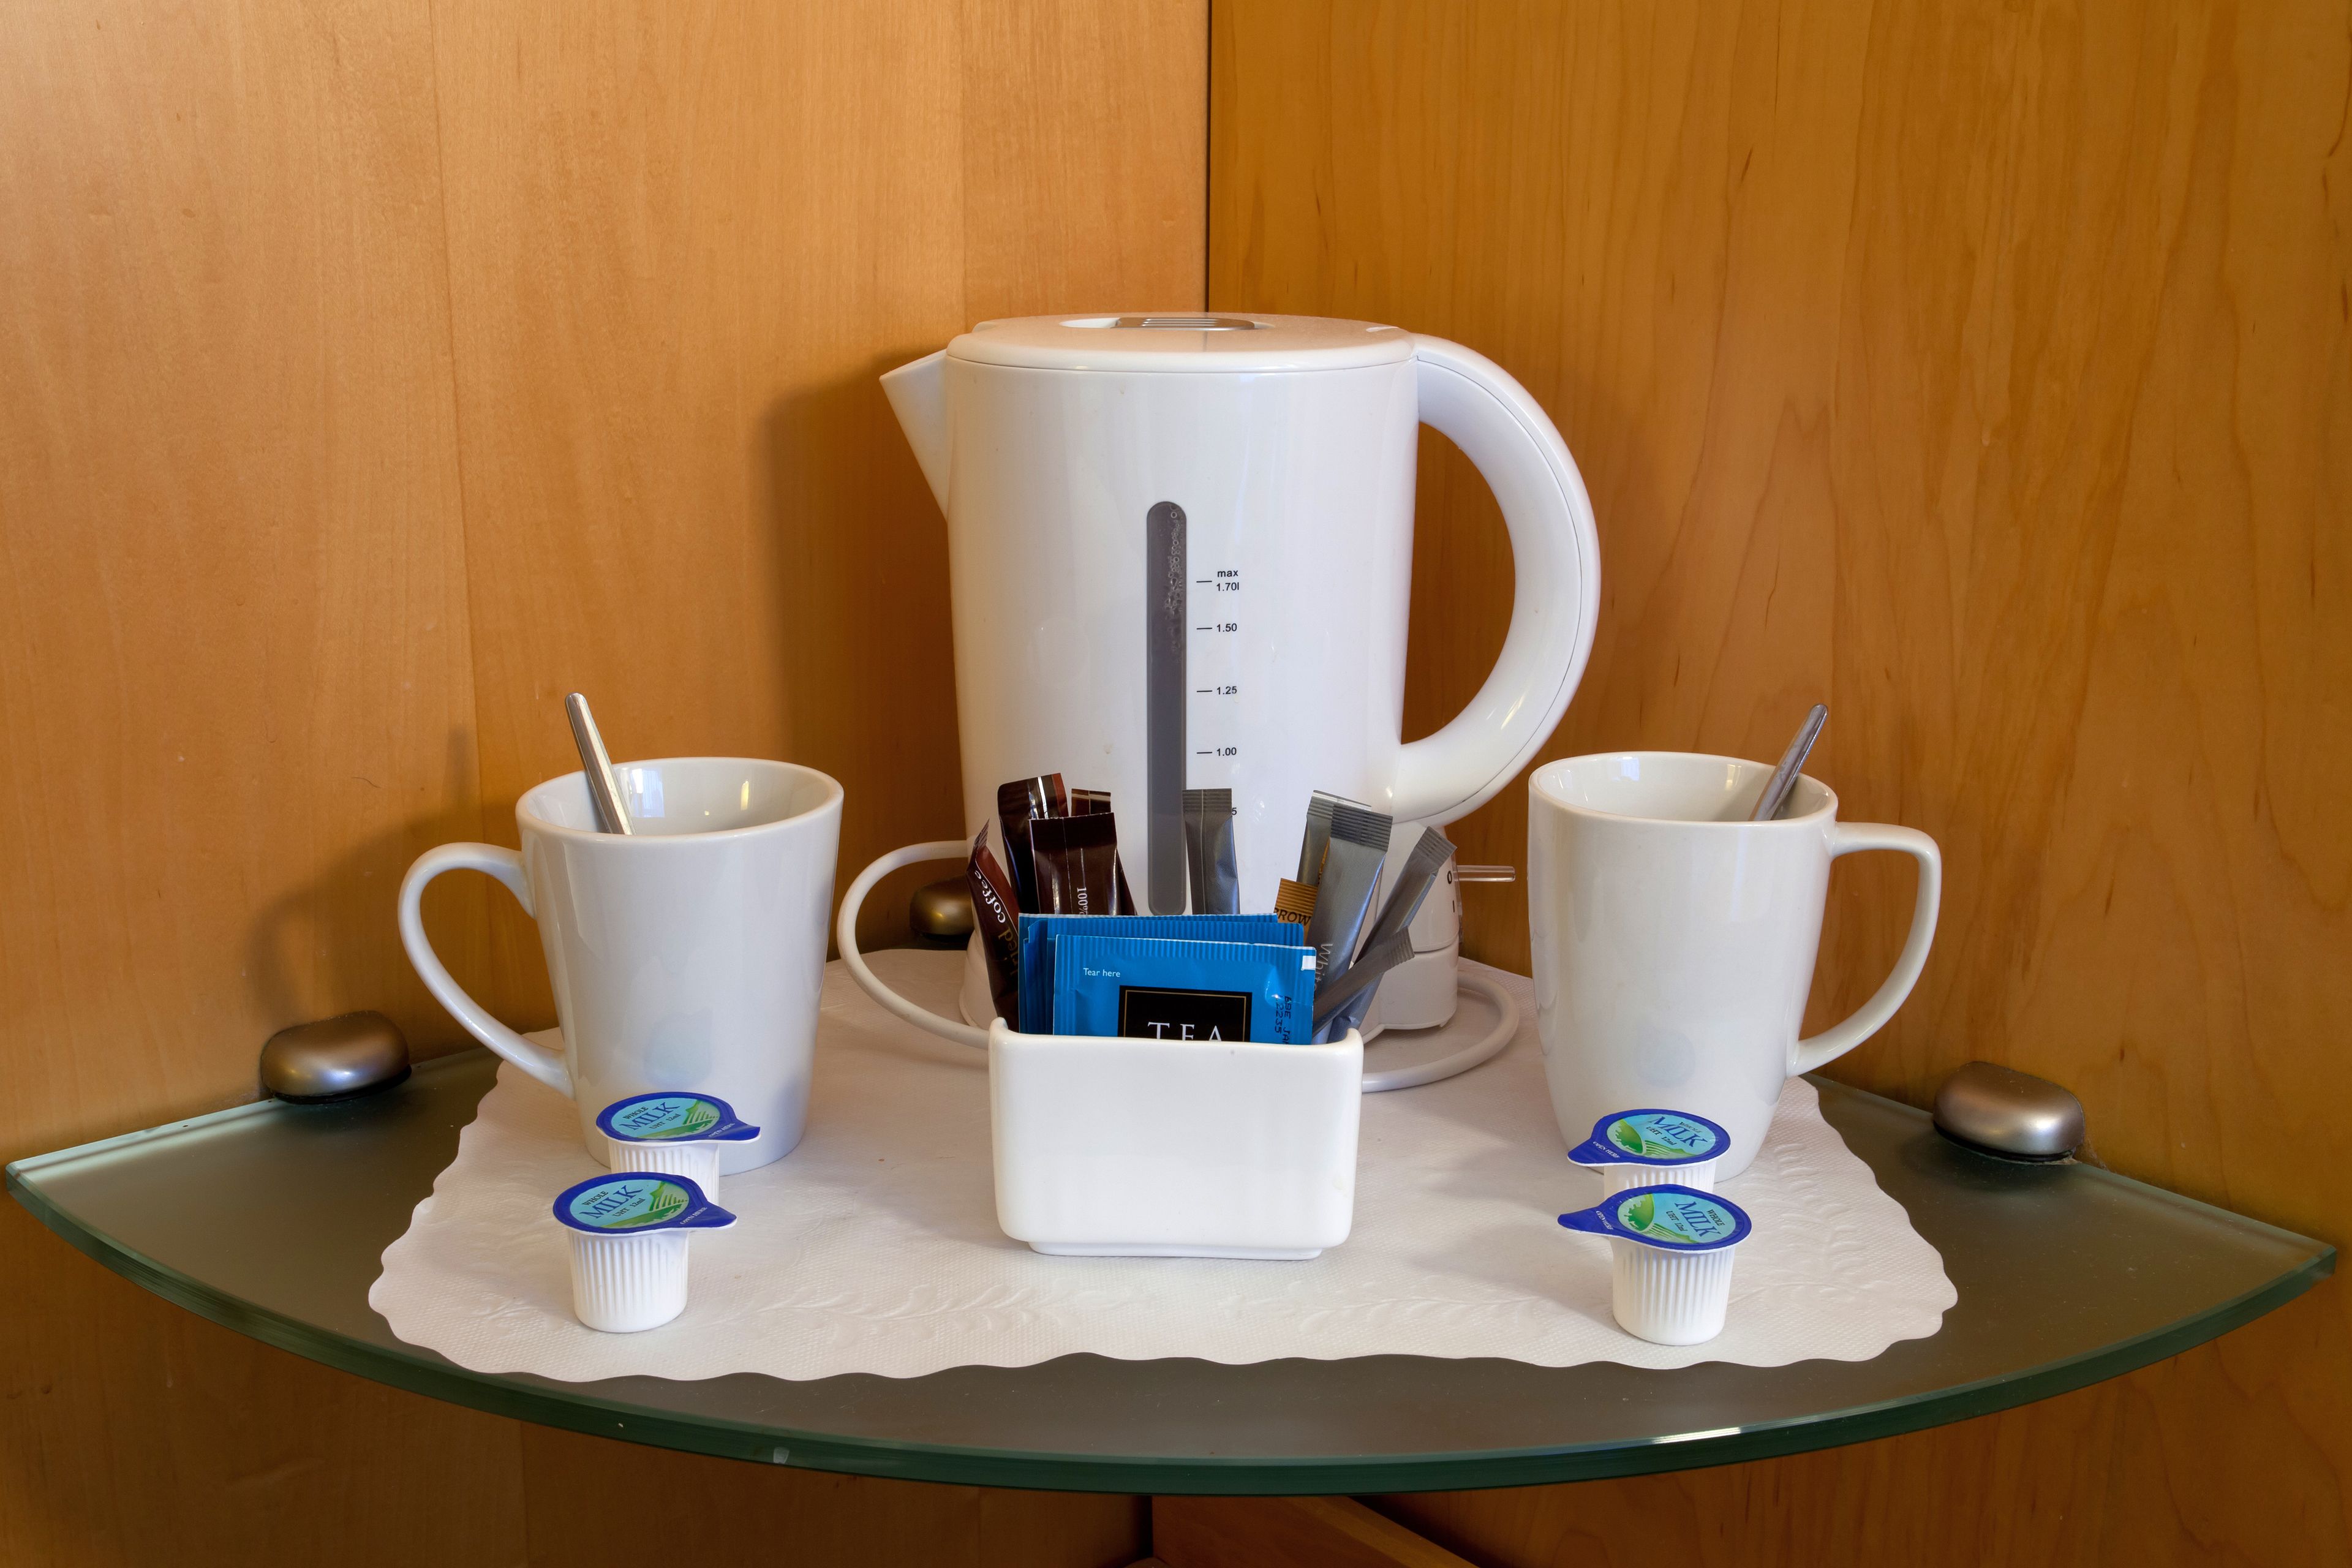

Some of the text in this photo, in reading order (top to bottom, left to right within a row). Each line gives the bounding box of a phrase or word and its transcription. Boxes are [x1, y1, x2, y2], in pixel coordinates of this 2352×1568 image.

[1216, 623, 1237, 633] 1.50
[1216, 686, 1237, 695] 1.25
[1216, 747, 1237, 756] 1.00
[974, 870, 1006, 923] coffee
[1083, 968, 1120, 978] Tear here
[1314, 943, 1333, 991] Whit
[619, 1102, 680, 1130] MILK
[622, 1106, 649, 1120] WHOLE
[1646, 1126, 1677, 1145] UHT 12ml
[1648, 1117, 1708, 1147] MILK
[579, 1185, 644, 1219] MILK
[581, 1191, 609, 1205] WHOLE
[612, 1197, 646, 1217] UHT 12ml
[1666, 1210, 1679, 1221] UHT
[1675, 1201, 1722, 1237] MILK
[1706, 1209, 1725, 1226] WHOLE
